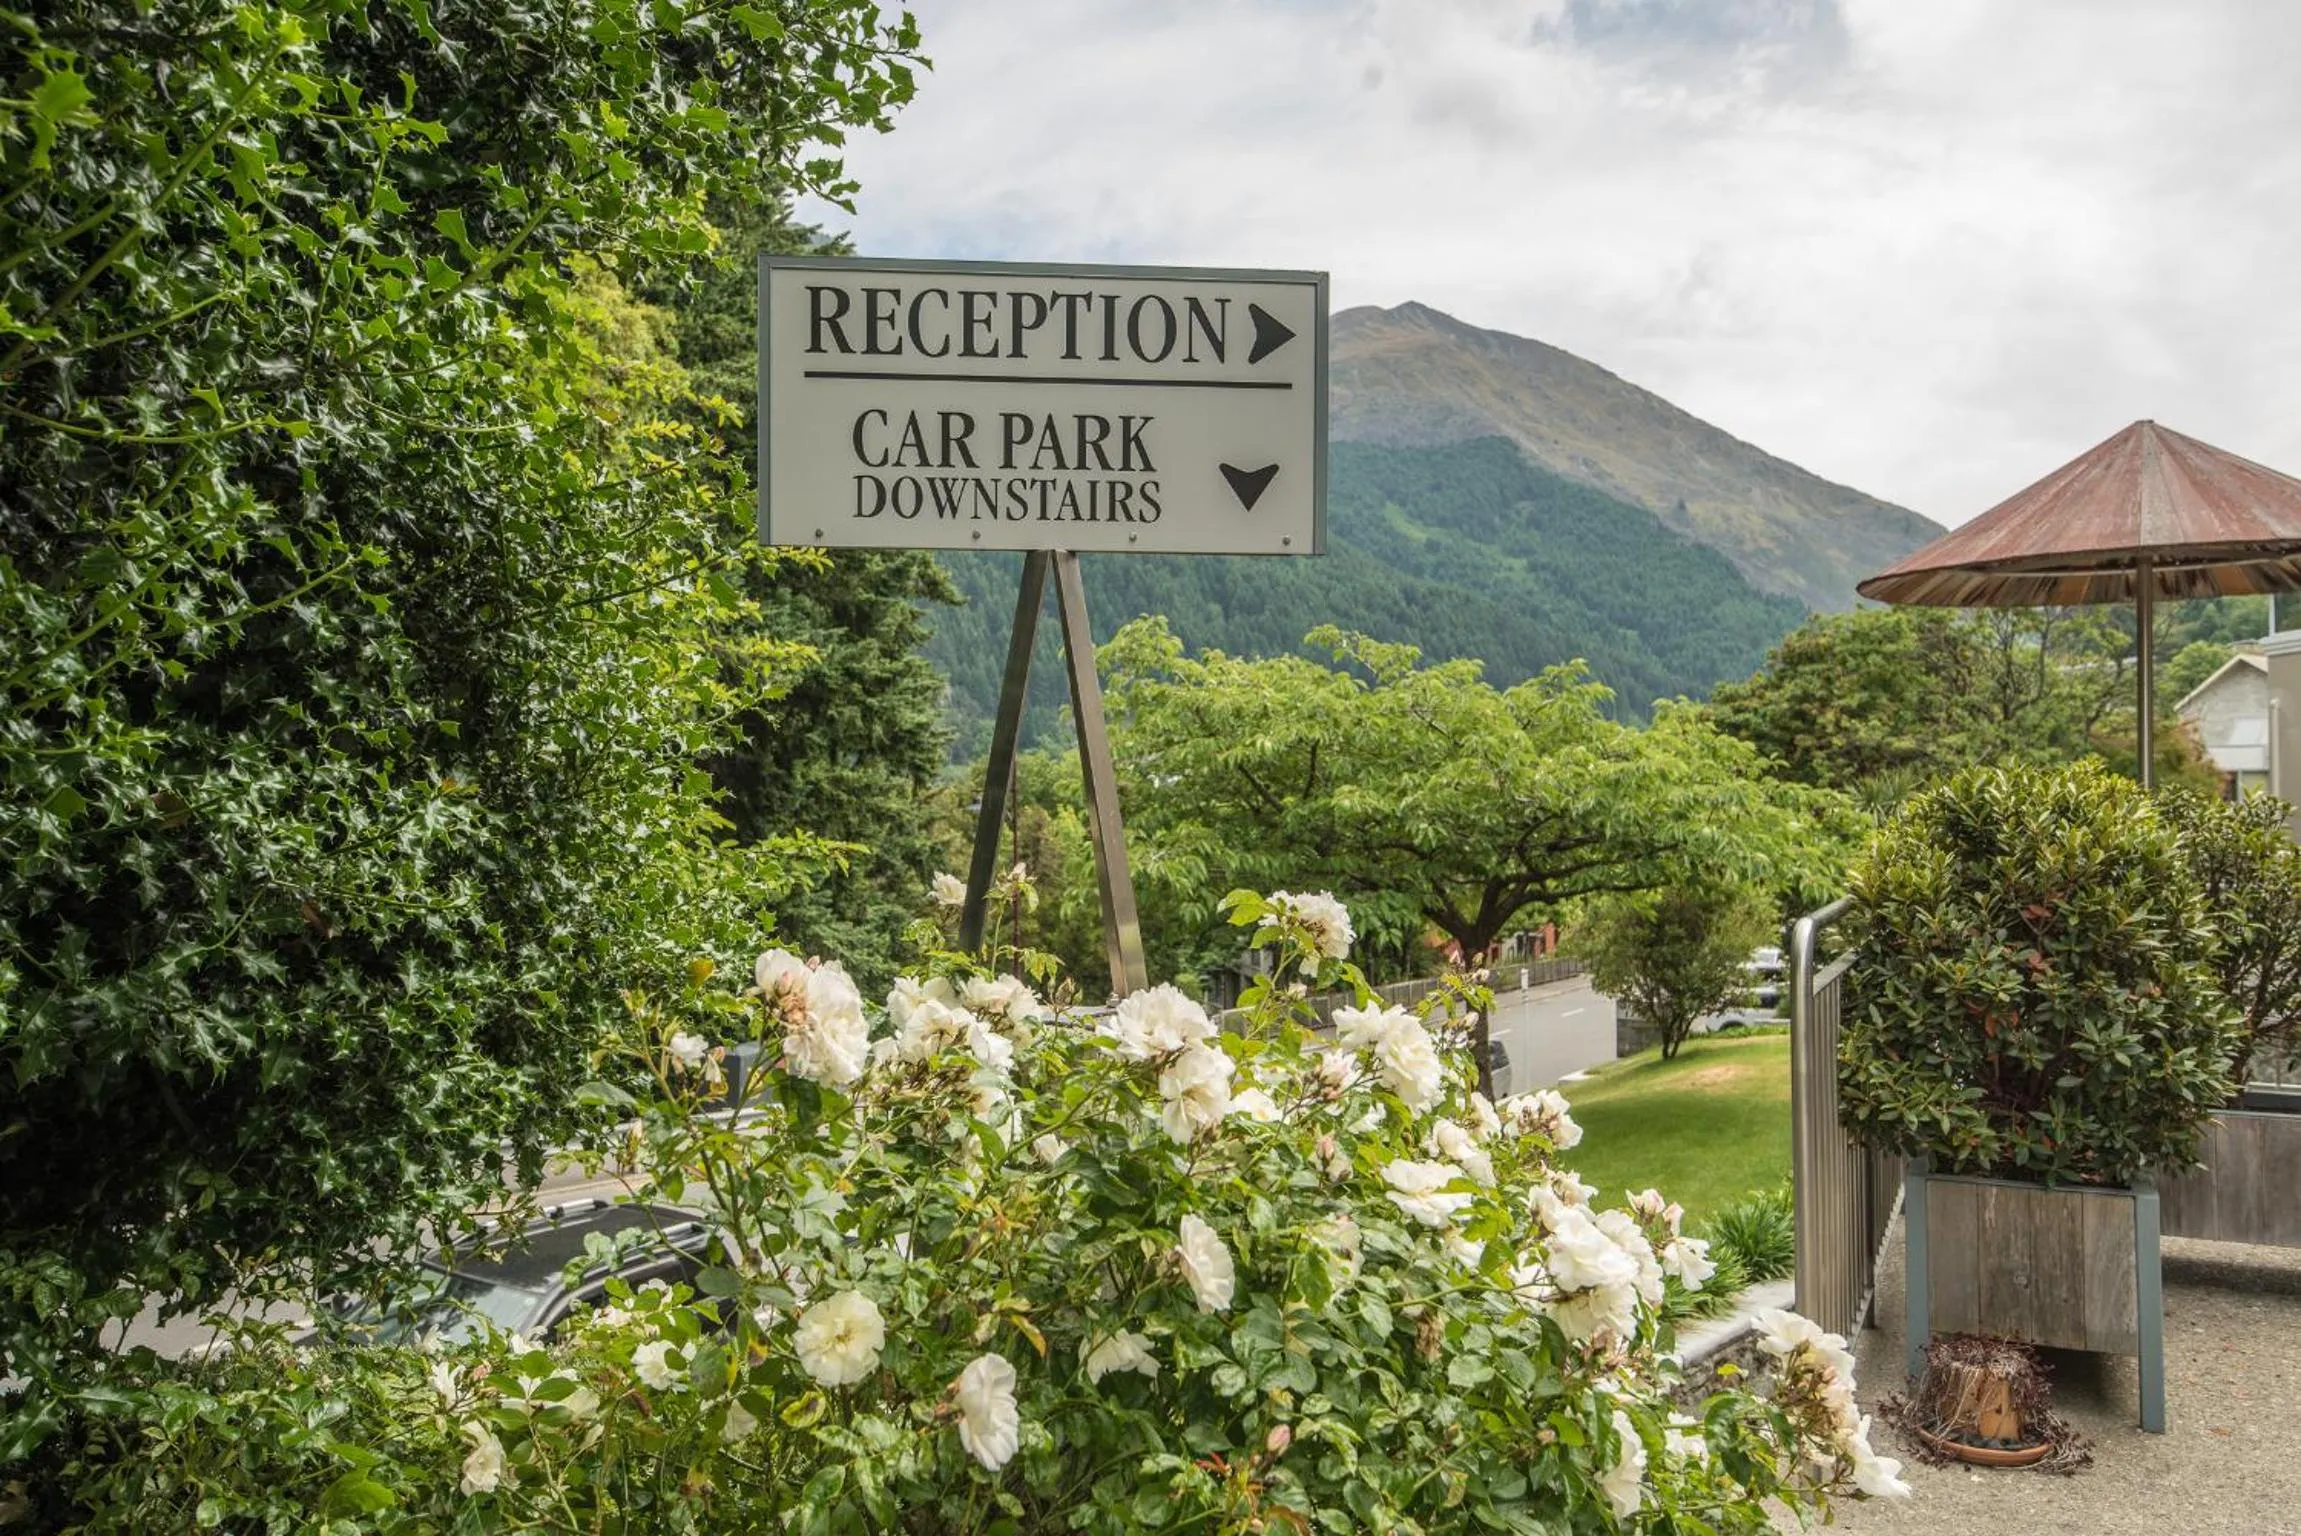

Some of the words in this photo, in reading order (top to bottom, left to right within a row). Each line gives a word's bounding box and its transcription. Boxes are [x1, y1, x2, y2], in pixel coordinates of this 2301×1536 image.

[804, 286, 1231, 365] RECEPTION
[852, 408, 980, 469] CAR
[998, 412, 1158, 472] PARK
[852, 474, 1162, 524] DOWNSTAIRS
